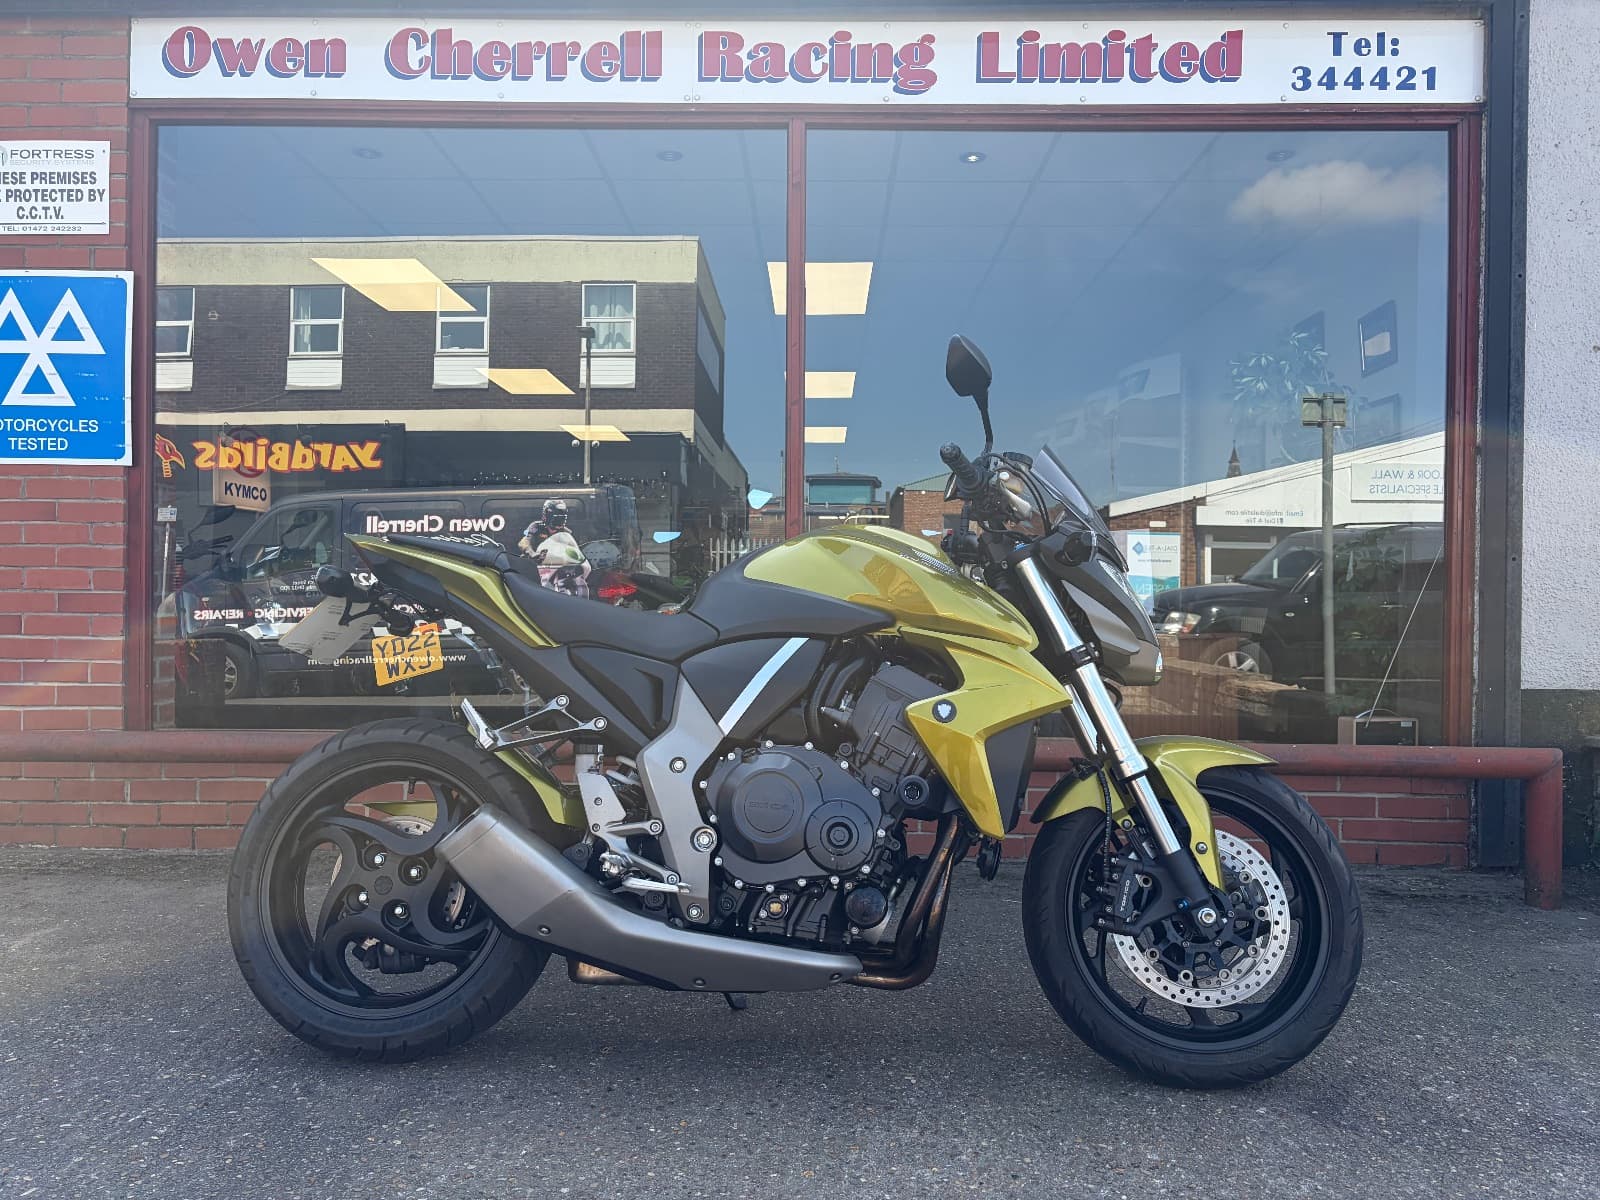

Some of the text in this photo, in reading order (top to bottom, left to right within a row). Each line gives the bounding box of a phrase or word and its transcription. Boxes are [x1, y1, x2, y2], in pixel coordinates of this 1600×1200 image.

[1326, 31, 1400, 57] Tel:
[161, 25, 1244, 95] Owen Cherrell Racing Limited
[1291, 65, 1437, 92] 344421
[10, 149, 95, 159] FORTRESS
[0, 171, 97, 185] ESE PREMISES
[6, 188, 84, 203] PROTECTED
[88, 188, 106, 203] BY
[16, 206, 65, 219] C.C.T.V.
[0, 418, 99, 433] TORCYCLES
[8, 437, 69, 451] TESTED
[224, 481, 268, 501] KYMCO
